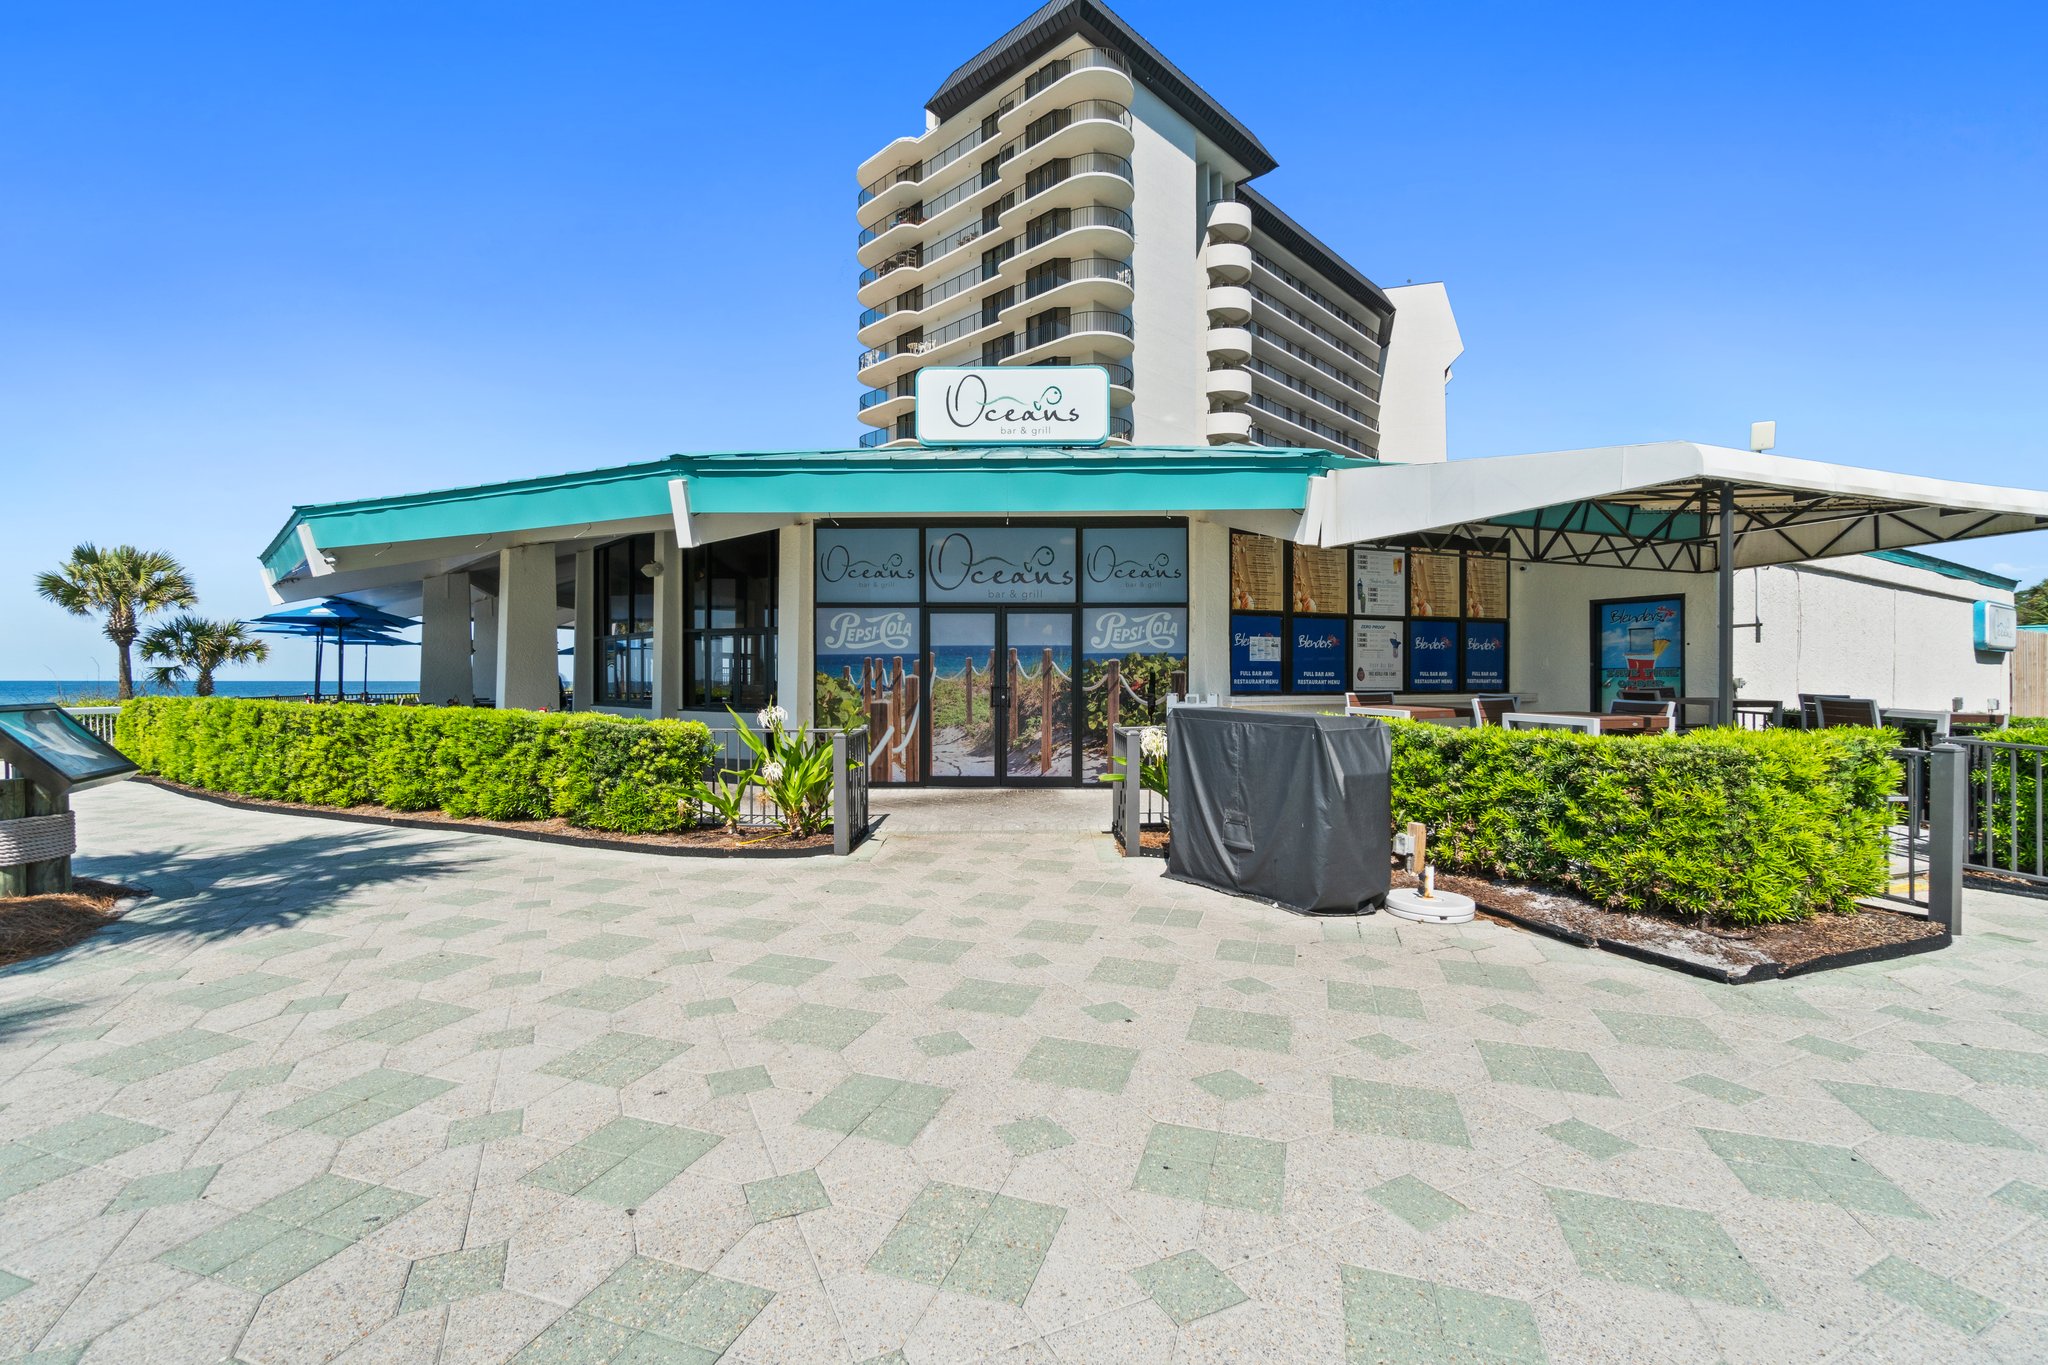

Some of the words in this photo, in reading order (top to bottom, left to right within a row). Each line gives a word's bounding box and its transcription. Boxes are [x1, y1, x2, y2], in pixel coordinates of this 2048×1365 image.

[946, 374, 1080, 428] Oceans
[1000, 426, 1016, 435] bar
[1020, 426, 1028, 435] &
[1031, 426, 1051, 437] grill
[820, 545, 915, 583] Oceans
[928, 533, 1074, 591] Oceans
[1086, 545, 1182, 583] Oceans
[880, 581, 895, 590] grill
[987, 590, 1005, 599] bar
[1009, 590, 1018, 599] &
[1021, 590, 1043, 601] grill
[1298, 634, 1332, 649] Blenders
[1415, 636, 1445, 650] Blenders
[1467, 637, 1496, 650] Blenders
